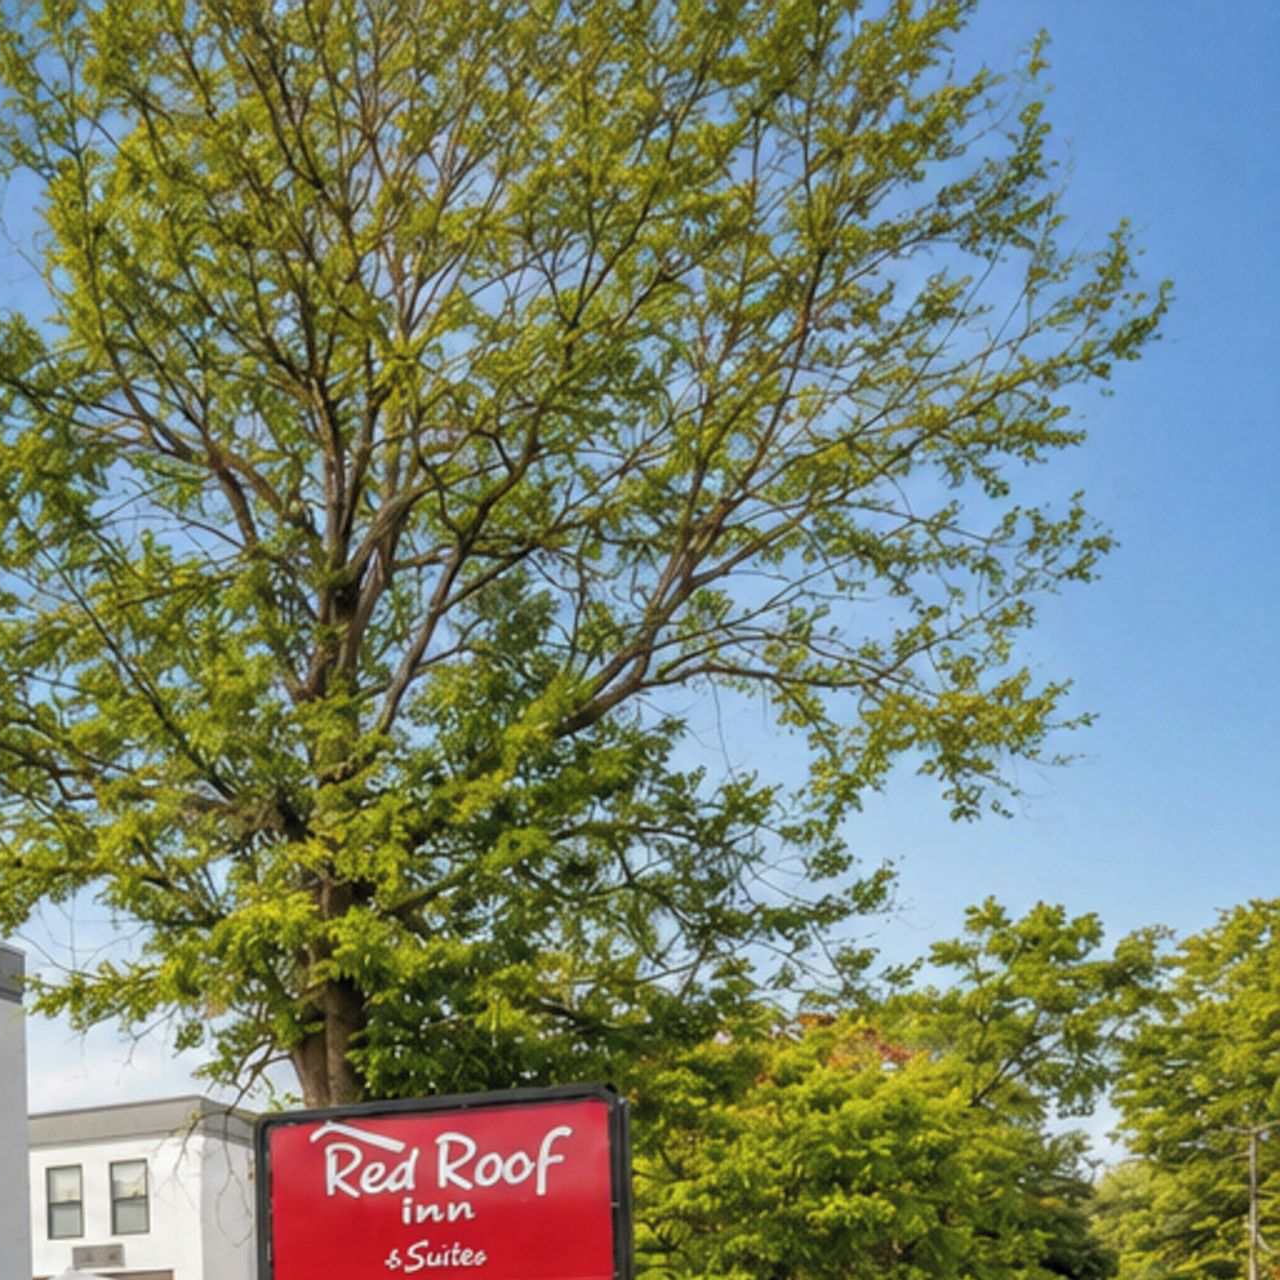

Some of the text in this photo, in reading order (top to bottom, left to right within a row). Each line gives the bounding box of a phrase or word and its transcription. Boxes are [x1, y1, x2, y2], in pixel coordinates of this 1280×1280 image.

[324, 1126, 573, 1198] Red Roof
[402, 1196, 476, 1224] inn
[404, 1240, 488, 1273] Suites
